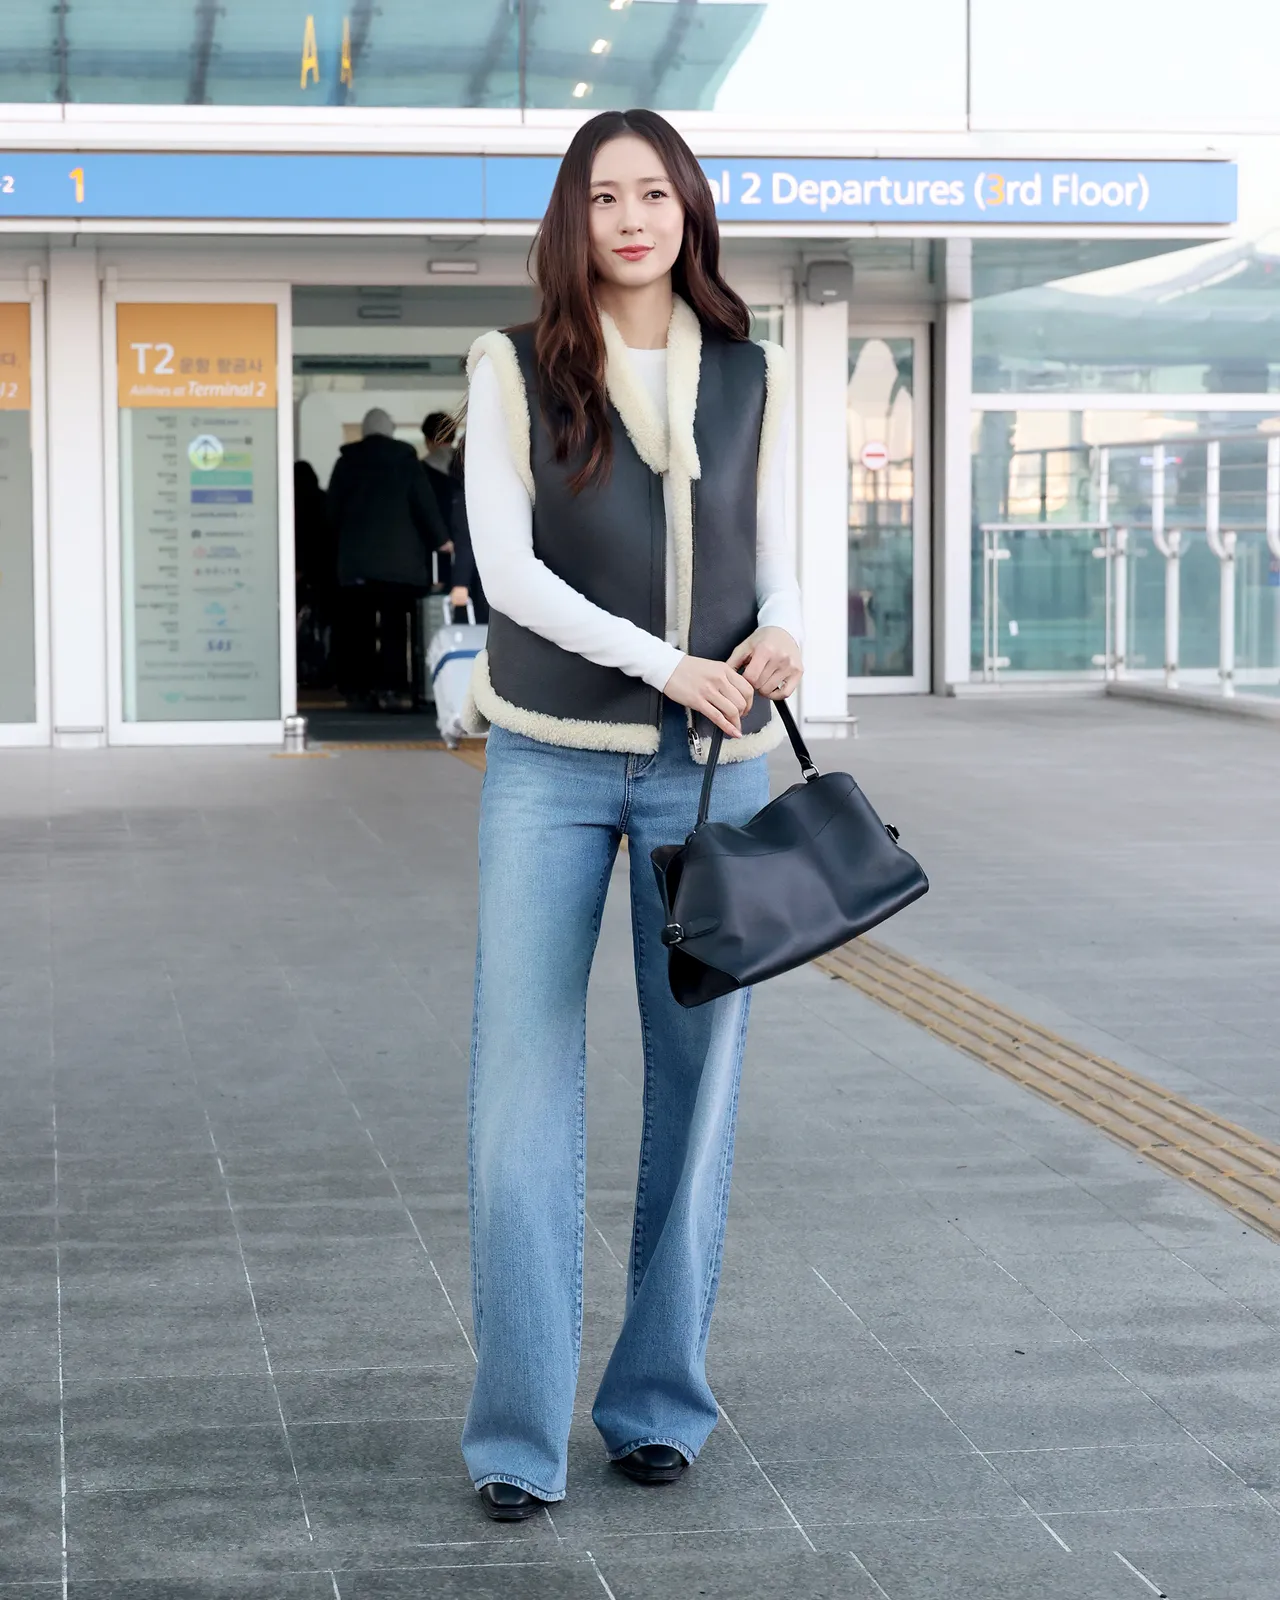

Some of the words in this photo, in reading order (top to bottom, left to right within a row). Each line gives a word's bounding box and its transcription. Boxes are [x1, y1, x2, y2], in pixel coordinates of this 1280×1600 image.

[300, 15, 320, 90] A
[0, 175, 15, 193] 2
[68, 167, 85, 204] 1
[740, 171, 762, 205] 2
[772, 171, 965, 212] Departures
[974, 171, 1042, 212] (3rd
[1053, 172, 1150, 212] Floor)
[130, 342, 175, 375] T2
[187, 380, 254, 398] Terminal
[255, 382, 267, 398] 2
